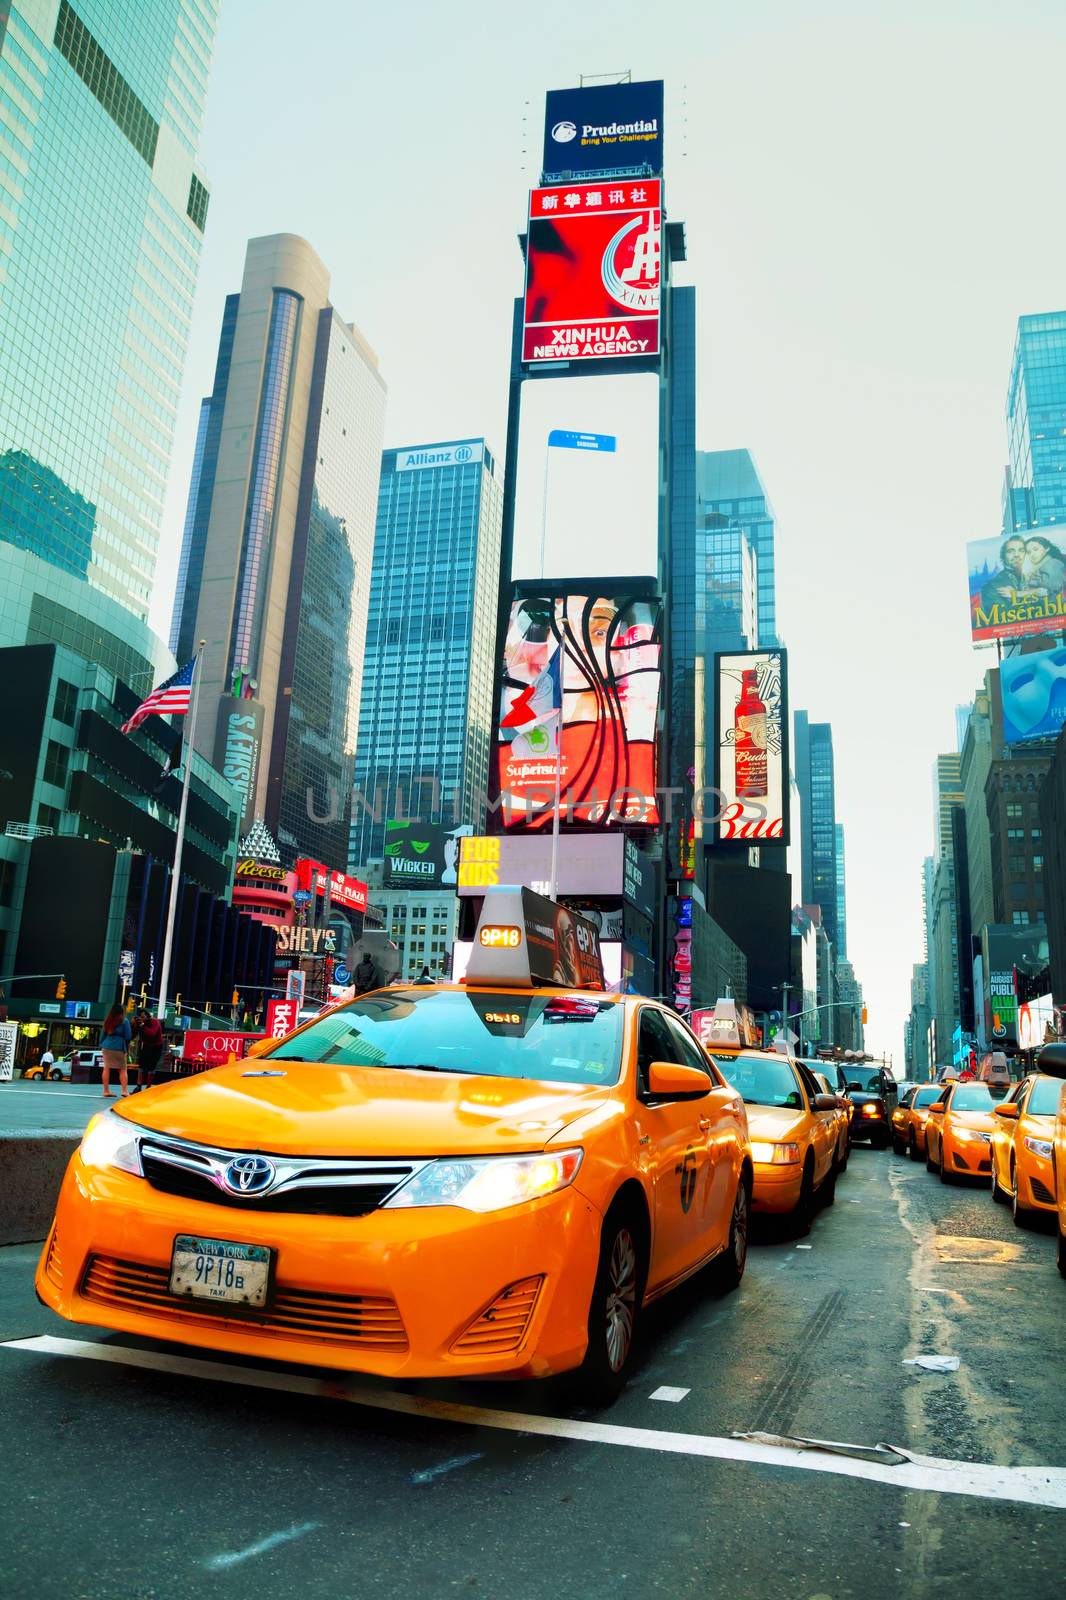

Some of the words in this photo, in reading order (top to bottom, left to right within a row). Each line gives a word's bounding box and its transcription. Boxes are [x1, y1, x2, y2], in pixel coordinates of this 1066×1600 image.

[582, 119, 658, 138] Prudential
[581, 138, 600, 146] Bring
[619, 132, 658, 142] Challenges
[541, 187, 648, 210] 新华通讯社
[551, 325, 632, 345] XINHUA
[533, 343, 580, 358] NEWS
[581, 339, 649, 355] AGENCY
[405, 451, 452, 466] Allianz
[1010, 589, 1039, 607] Les
[237, 859, 288, 881] Reese's
[344, 885, 365, 903] PLAZA
[481, 928, 519, 946] 9P18
[990, 984, 1016, 996] PUBLI
[203, 1036, 244, 1052] CORT
[198, 1242, 219, 1256] NEW
[222, 1246, 248, 1260] YORK
[209, 1288, 226, 1297] TAXI
